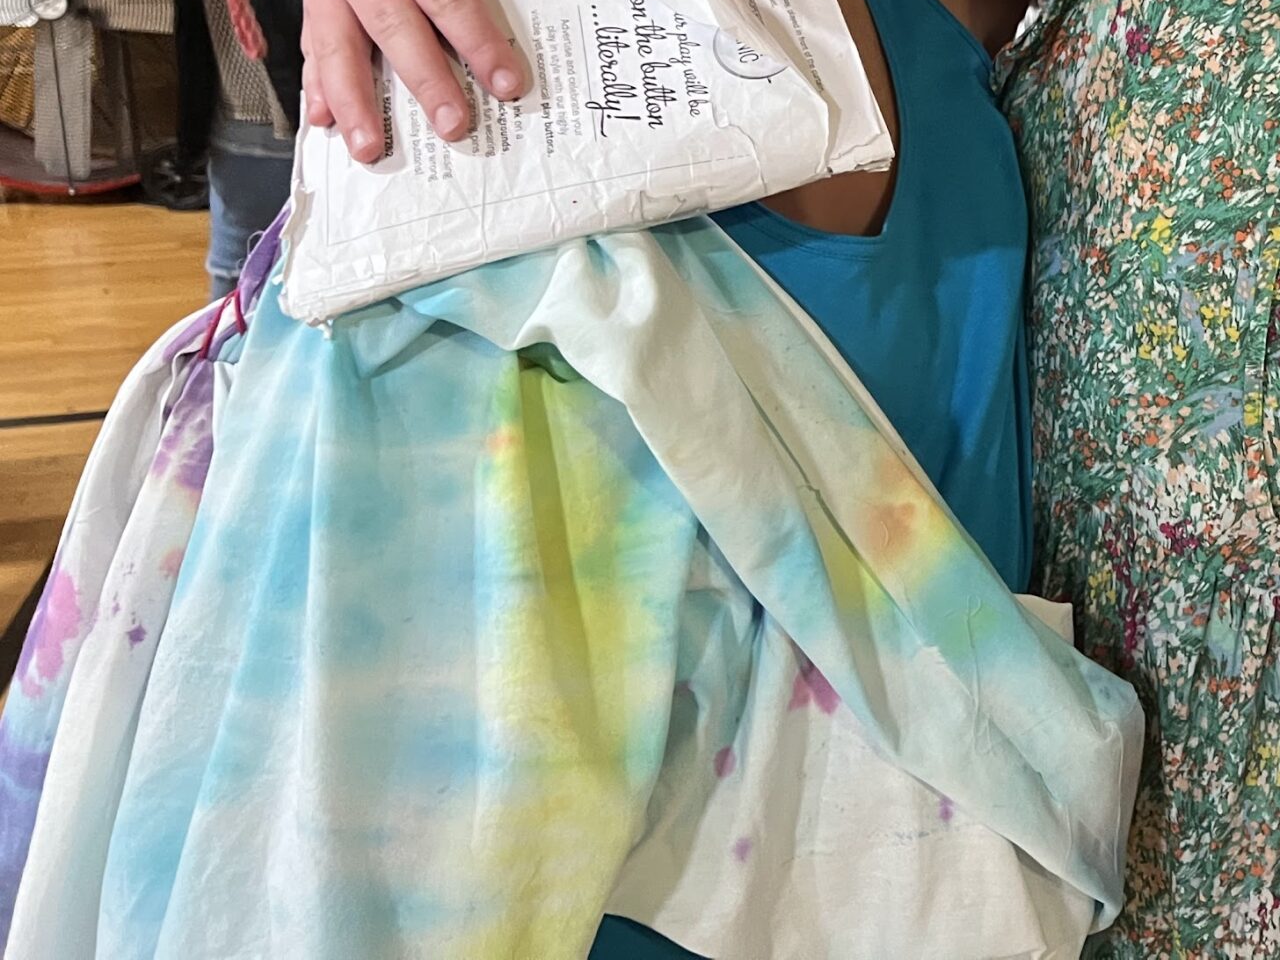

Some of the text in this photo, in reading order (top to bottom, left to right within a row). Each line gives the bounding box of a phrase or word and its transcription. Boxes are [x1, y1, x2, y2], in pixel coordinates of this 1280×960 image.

[634, 20, 667, 57] the
[666, 33, 701, 68] play
[381, 78, 391, 95] Call
[530, 8, 556, 158] visible yet economical play buttons.
[545, 24, 568, 137] play in style with our highly
[559, 17, 583, 137] Advertise and celebrate your
[585, 5, 641, 137] ...literally!
[683, 69, 709, 96] will
[464, 80, 477, 134] eye-catching
[511, 103, 523, 119] ink
[640, 61, 677, 129] button
[688, 100, 709, 117] be
[409, 109, 419, 138] quality
[482, 106, 493, 122] fun
[514, 119, 525, 132] on
[425, 141, 436, 154] go
[484, 123, 495, 158] wearing
[514, 132, 525, 140] a
[412, 138, 422, 176] buttons!
